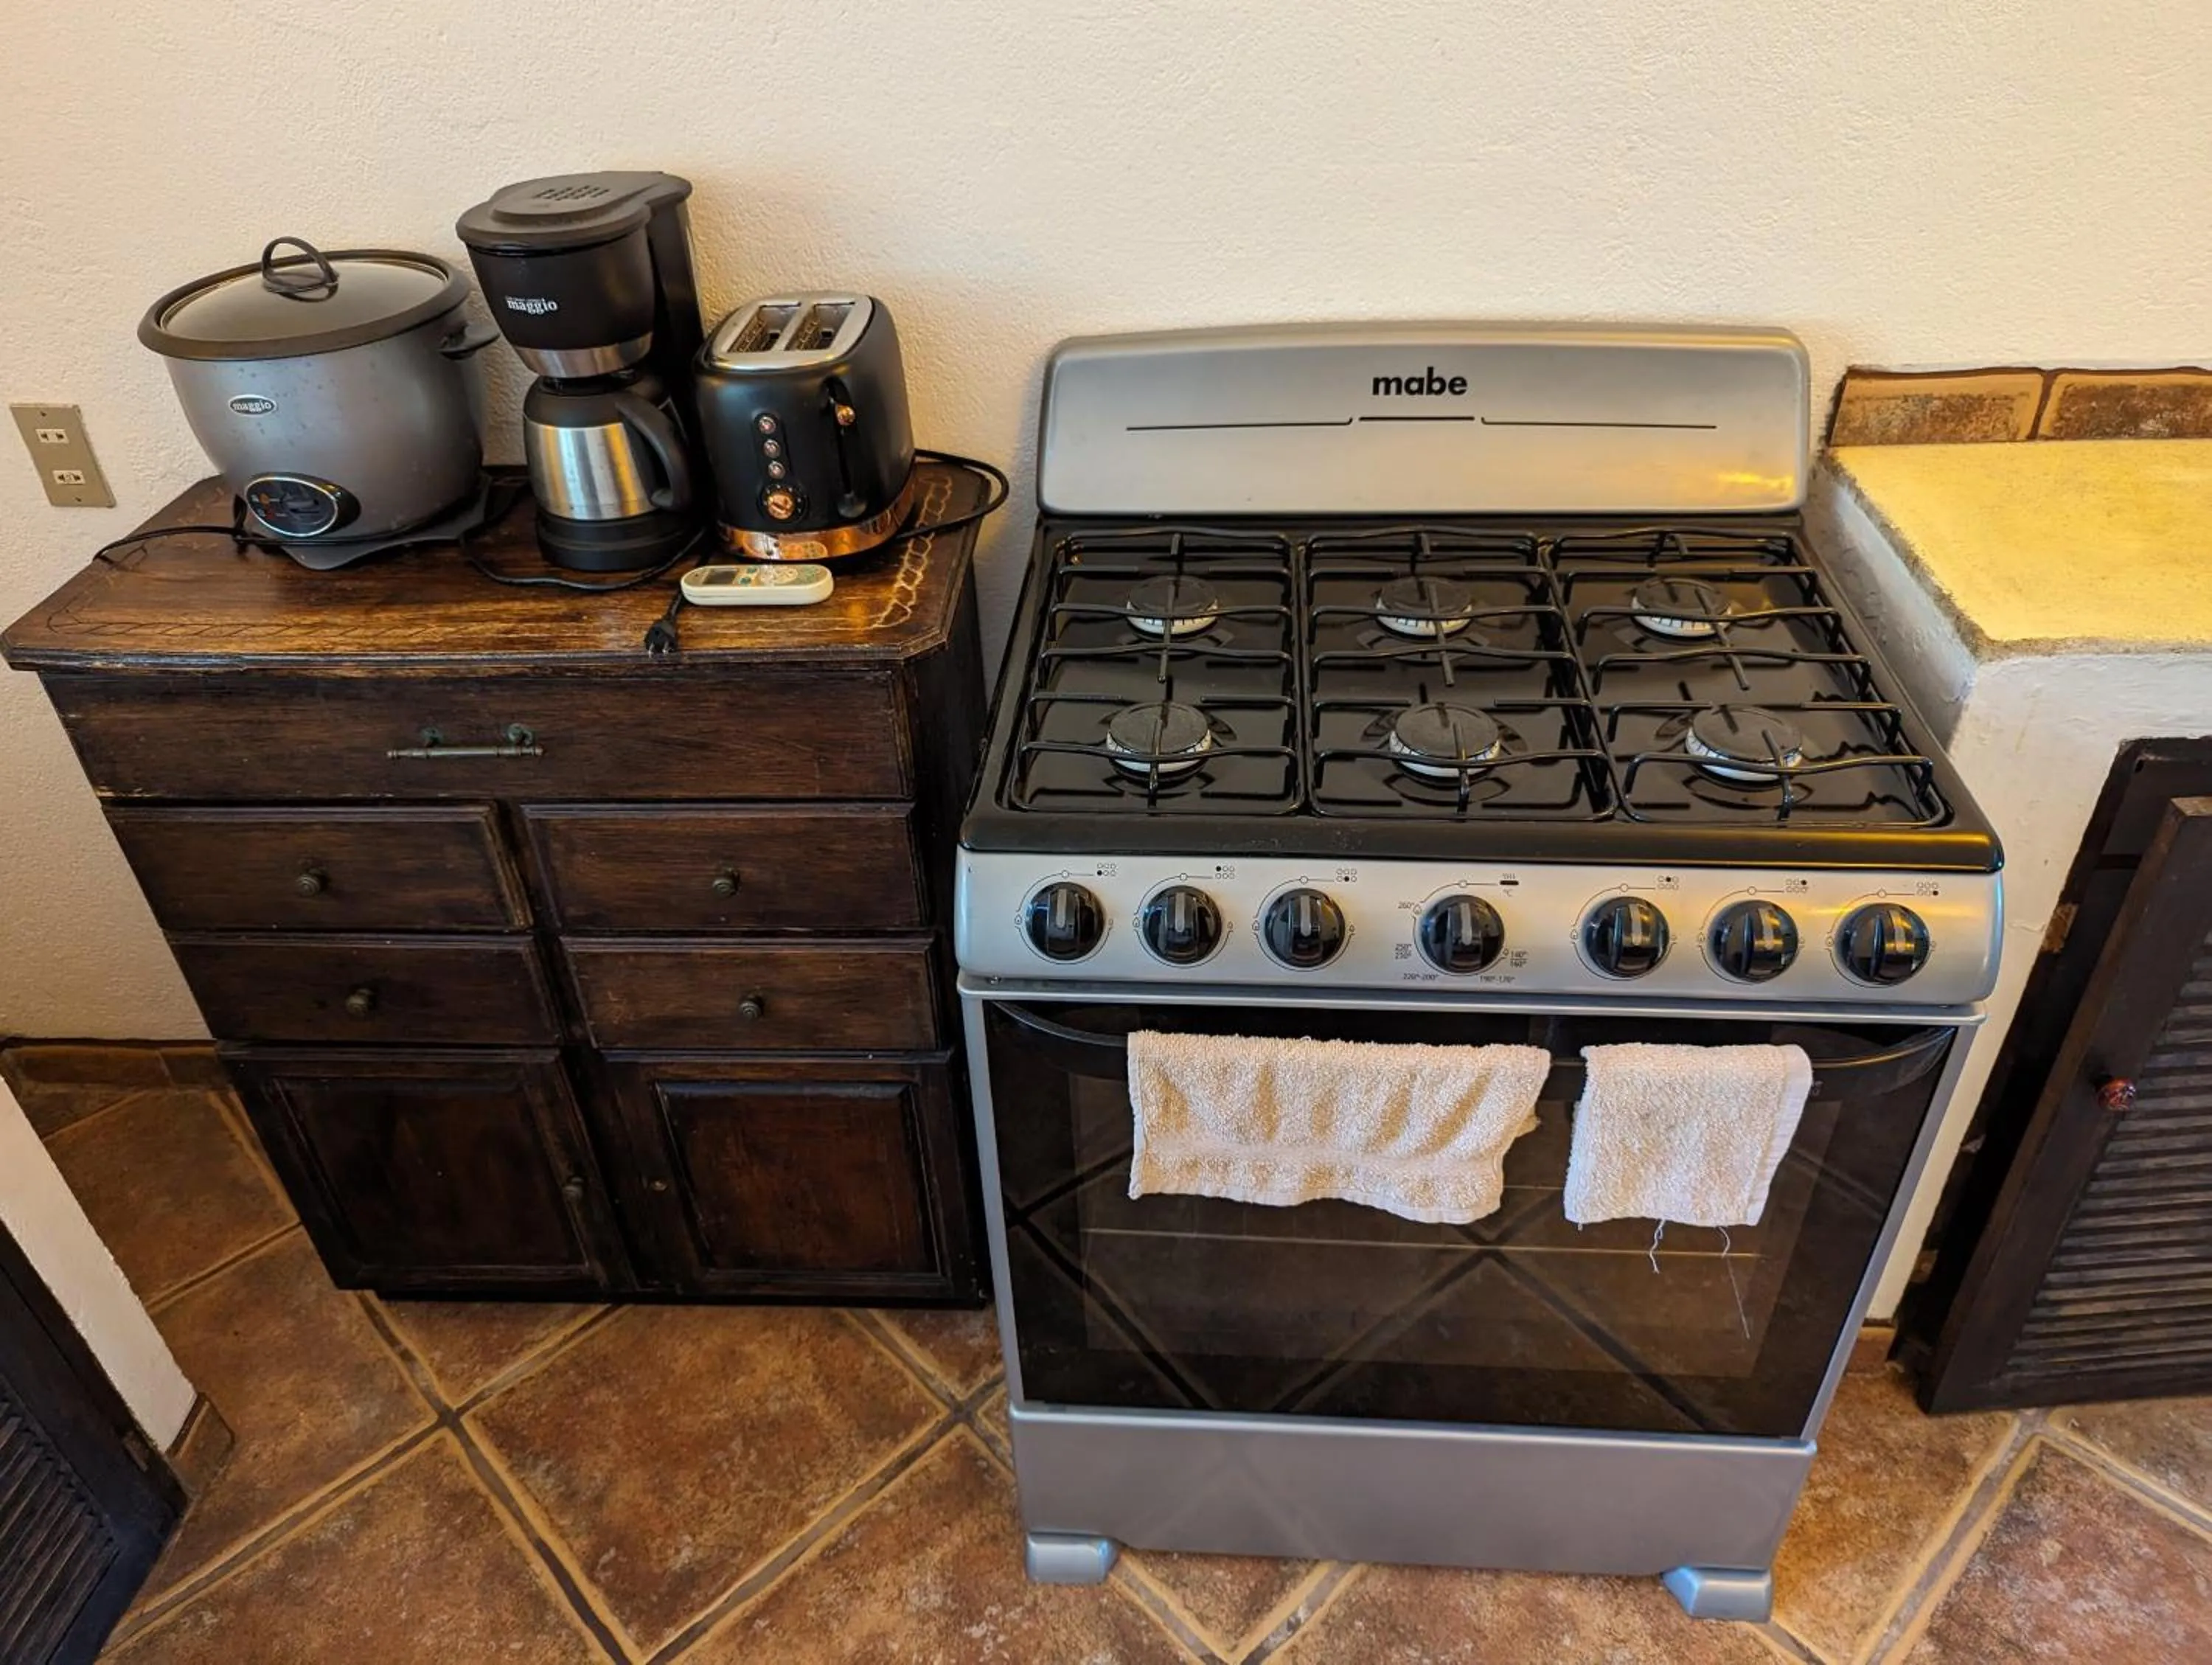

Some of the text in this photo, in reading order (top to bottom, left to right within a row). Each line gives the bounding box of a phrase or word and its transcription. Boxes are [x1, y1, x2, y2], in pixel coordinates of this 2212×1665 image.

[507, 297, 558, 314] maggio
[1372, 366, 1467, 396] mabe
[232, 400, 272, 413] maggio
